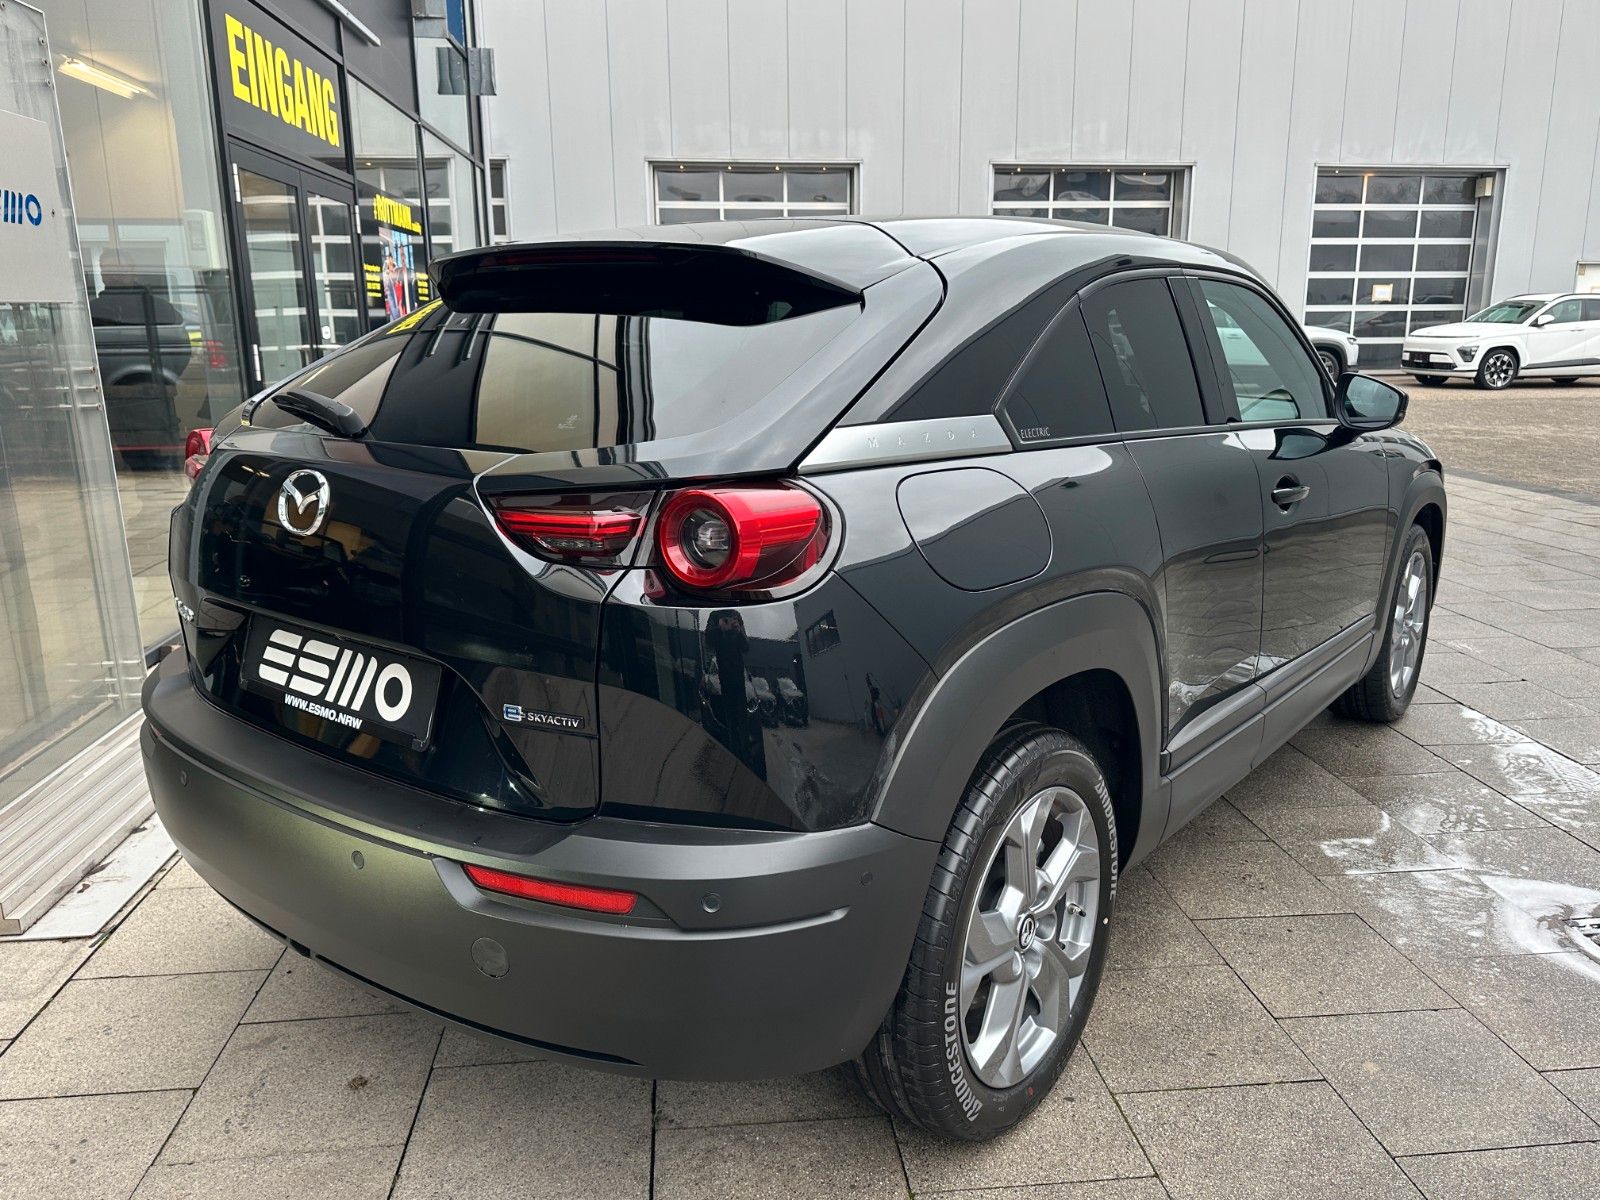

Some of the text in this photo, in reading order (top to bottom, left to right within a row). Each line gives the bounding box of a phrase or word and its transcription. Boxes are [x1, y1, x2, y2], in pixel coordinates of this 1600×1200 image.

[225, 13, 339, 148] EINGANG
[1020, 426, 1051, 439] ELECTRIC
[258, 628, 412, 722] ESMO
[284, 693, 363, 730] WWW.ESMO.NRW
[527, 712, 580, 728] SKYACTIV
[943, 981, 984, 1122] BRIDGESTONE
